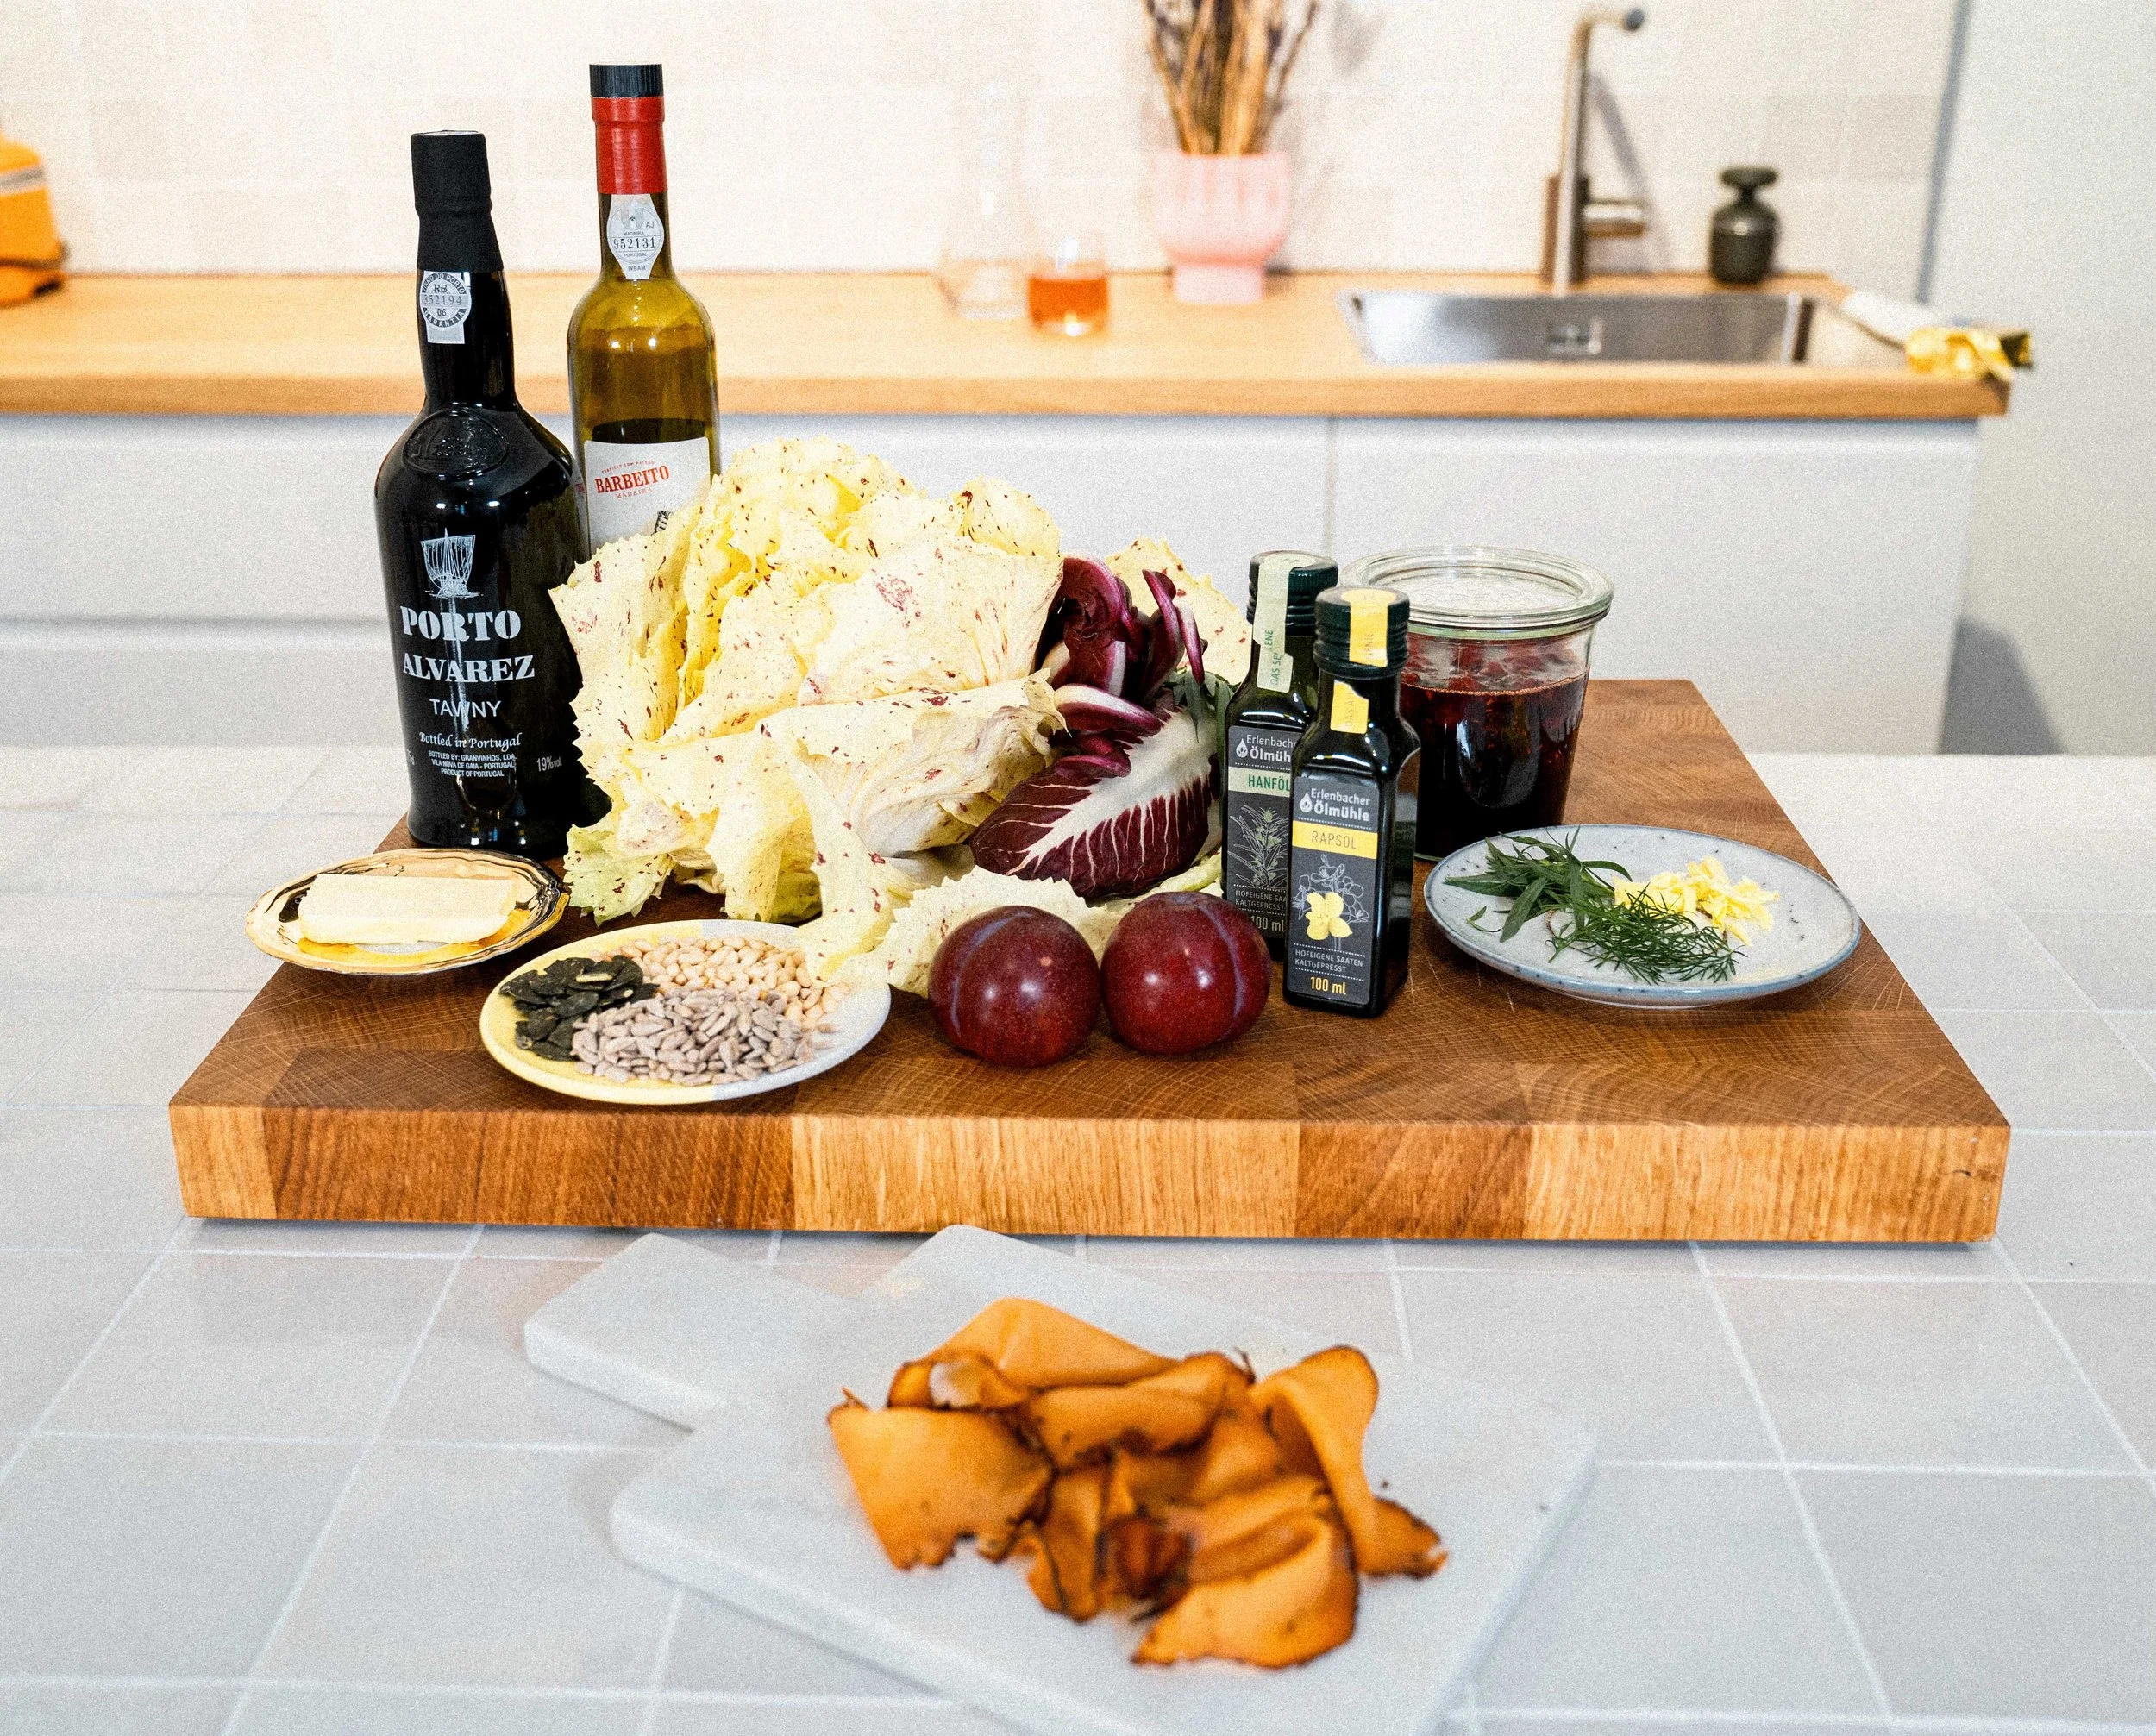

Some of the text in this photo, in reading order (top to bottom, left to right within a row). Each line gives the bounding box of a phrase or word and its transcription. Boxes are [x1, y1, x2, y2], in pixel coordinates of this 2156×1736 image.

[613, 236, 656, 250] 952131
[434, 284, 448, 293] RB
[446, 274, 466, 294] PORTO
[424, 309, 466, 328] GARANTIA
[594, 465, 670, 494] BARBEITO
[615, 486, 653, 499] MADEIRA
[399, 605, 522, 642] PORTO
[402, 653, 536, 683] ALVAREZ
[429, 699, 502, 718] TAWNY
[418, 731, 523, 753] Bottled in Portugal
[428, 749, 450, 761] BOTTLED
[442, 760, 457, 768] NOVA
[441, 768, 465, 777] PRODUCT
[1248, 774, 1291, 792] HANFÖL
[1310, 787, 1371, 806] Erlenbacher
[1313, 799, 1370, 822] Ölmühle
[1235, 889, 1273, 901] HOFEIGENE
[1235, 899, 1285, 911] KALTGEPRESST
[1271, 919, 1285, 932] ml
[1294, 949, 1363, 967] HOFEIGENE SAATEN
[1294, 958, 1347, 973] KALTGEPRESST
[1310, 976, 1347, 996] 100 ml
